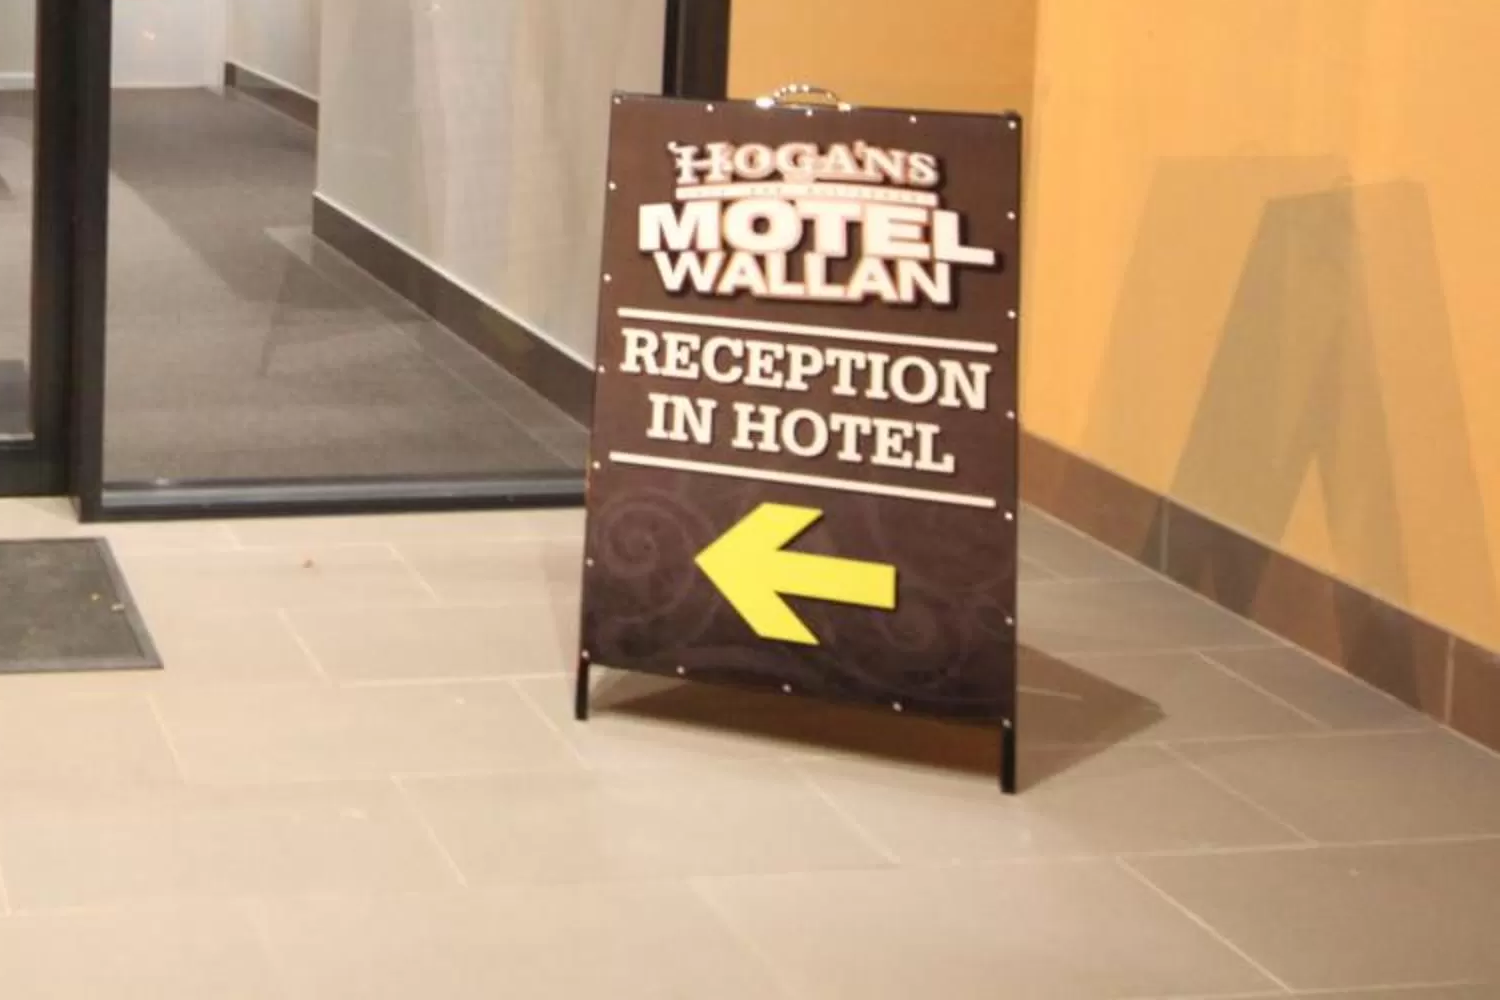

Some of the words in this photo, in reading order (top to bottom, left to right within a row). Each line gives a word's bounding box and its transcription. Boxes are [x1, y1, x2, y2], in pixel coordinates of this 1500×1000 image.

[667, 140, 940, 187] HOGANS
[638, 200, 995, 265] MOTEL
[654, 251, 953, 304] WALLAN
[619, 327, 992, 411] RECEPTION
[646, 393, 717, 445] IN
[731, 402, 956, 474] HOTEL
